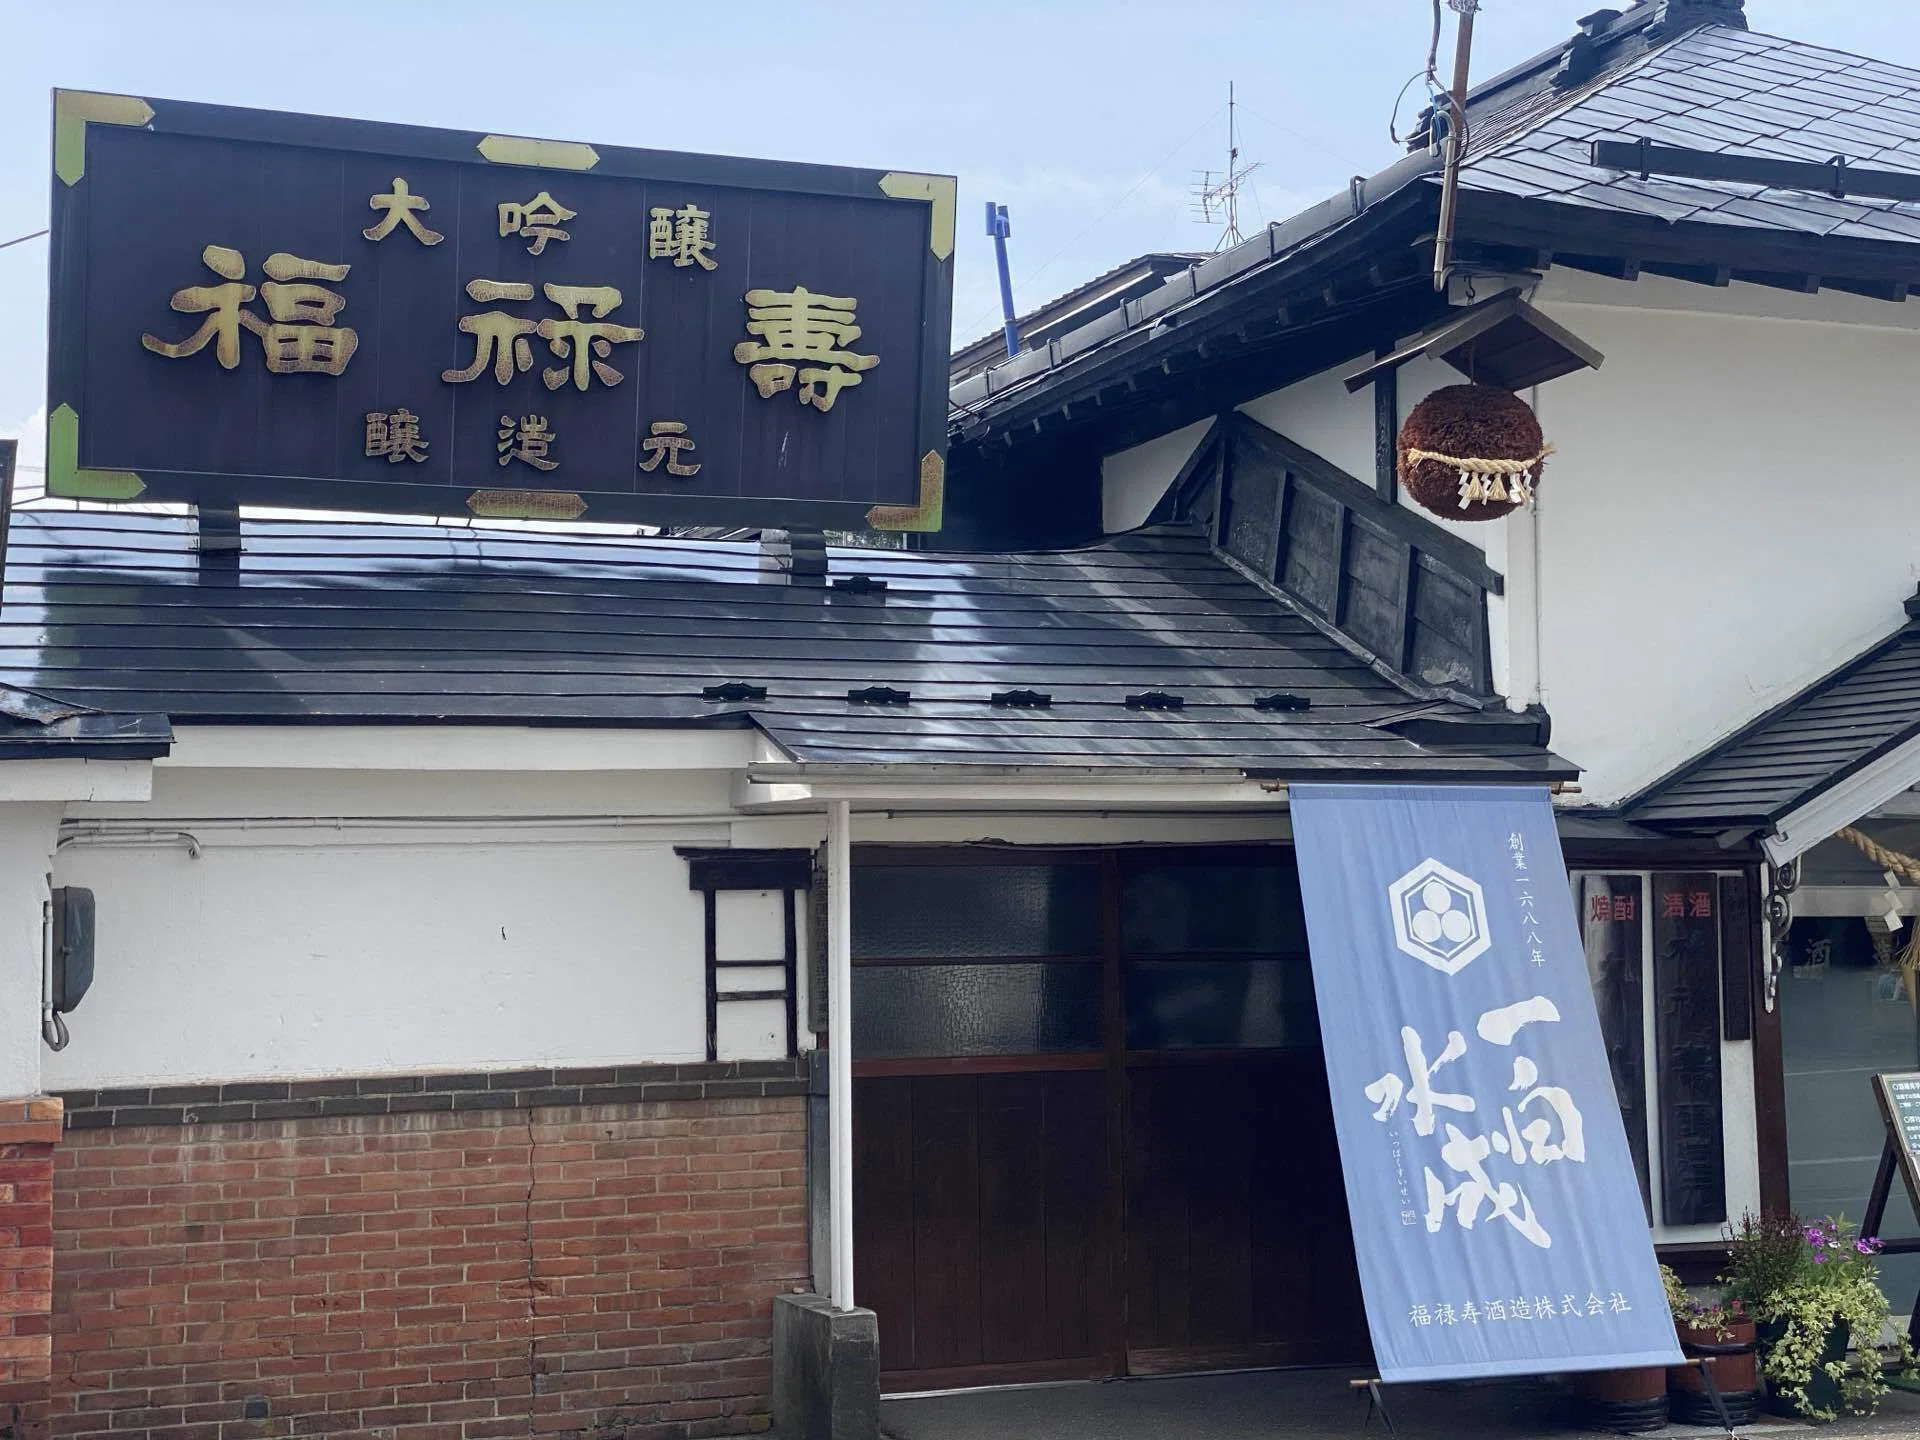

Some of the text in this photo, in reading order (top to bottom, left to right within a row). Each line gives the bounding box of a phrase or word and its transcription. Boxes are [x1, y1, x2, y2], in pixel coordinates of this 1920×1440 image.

[1508, 832, 1546, 967] 創業一六八八年
[1591, 895, 1635, 921] 焼酎
[1663, 891, 1711, 917] 清酒
[1408, 1291, 1633, 1328] 福禄寿酒造株式会社
